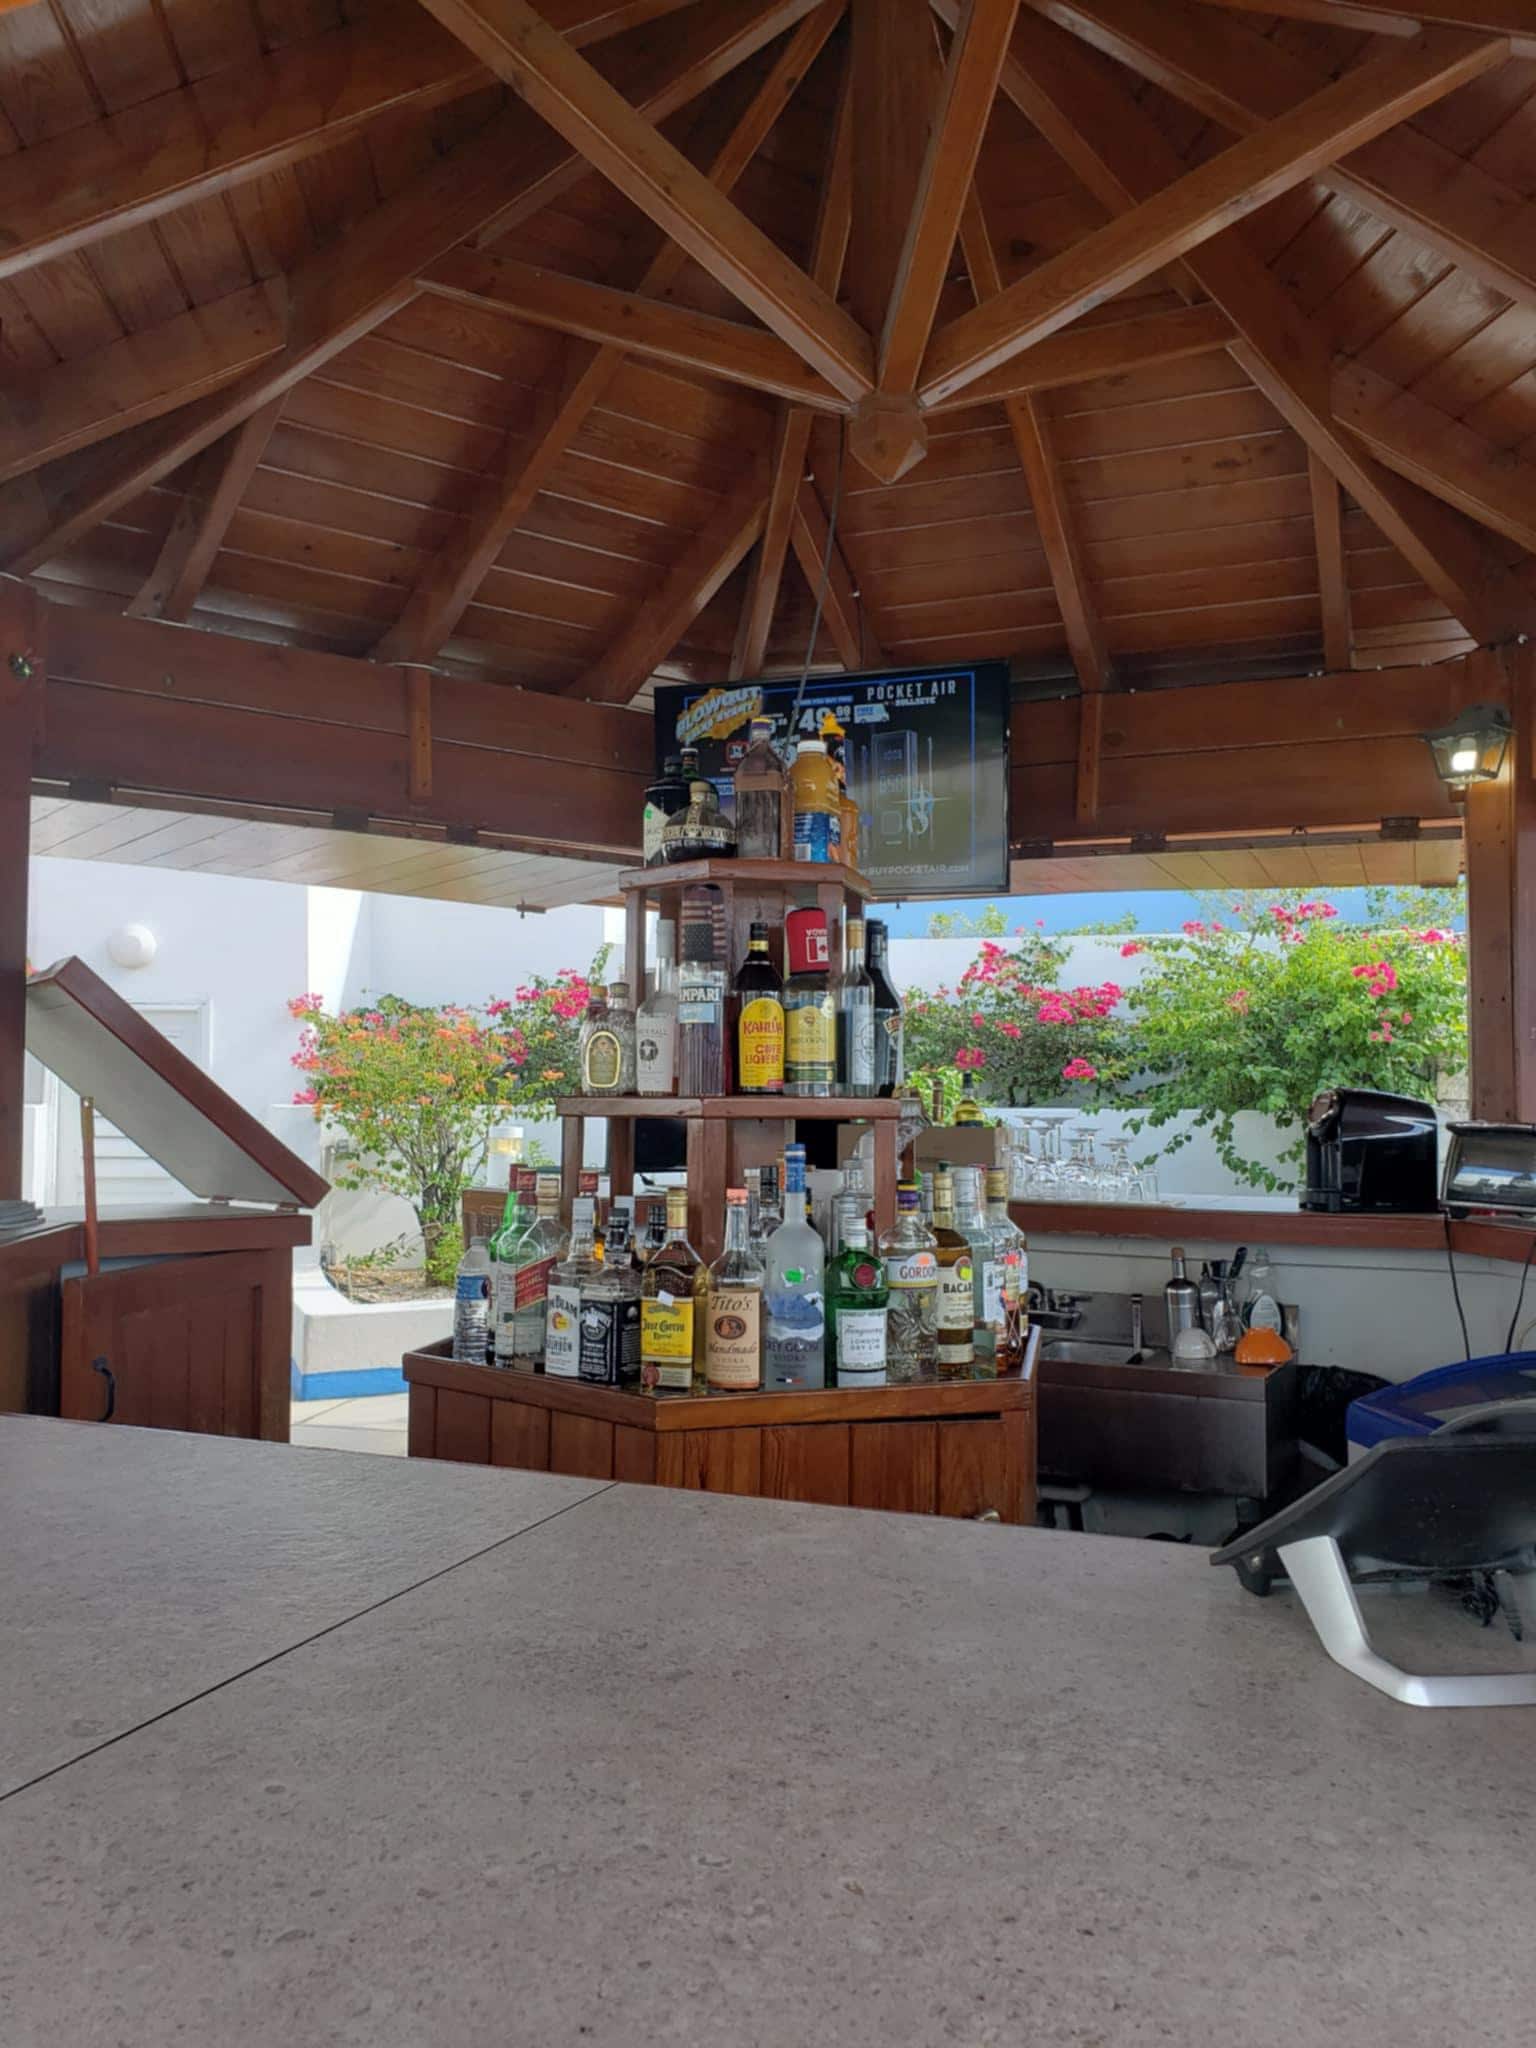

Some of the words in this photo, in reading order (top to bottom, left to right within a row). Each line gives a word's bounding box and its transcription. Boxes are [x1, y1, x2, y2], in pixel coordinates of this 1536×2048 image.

[867, 683, 922, 701] POCKET
[930, 680, 957, 696] AIR
[943, 1282, 973, 1294] BACAR
[711, 1295, 752, 1311] Tito's
